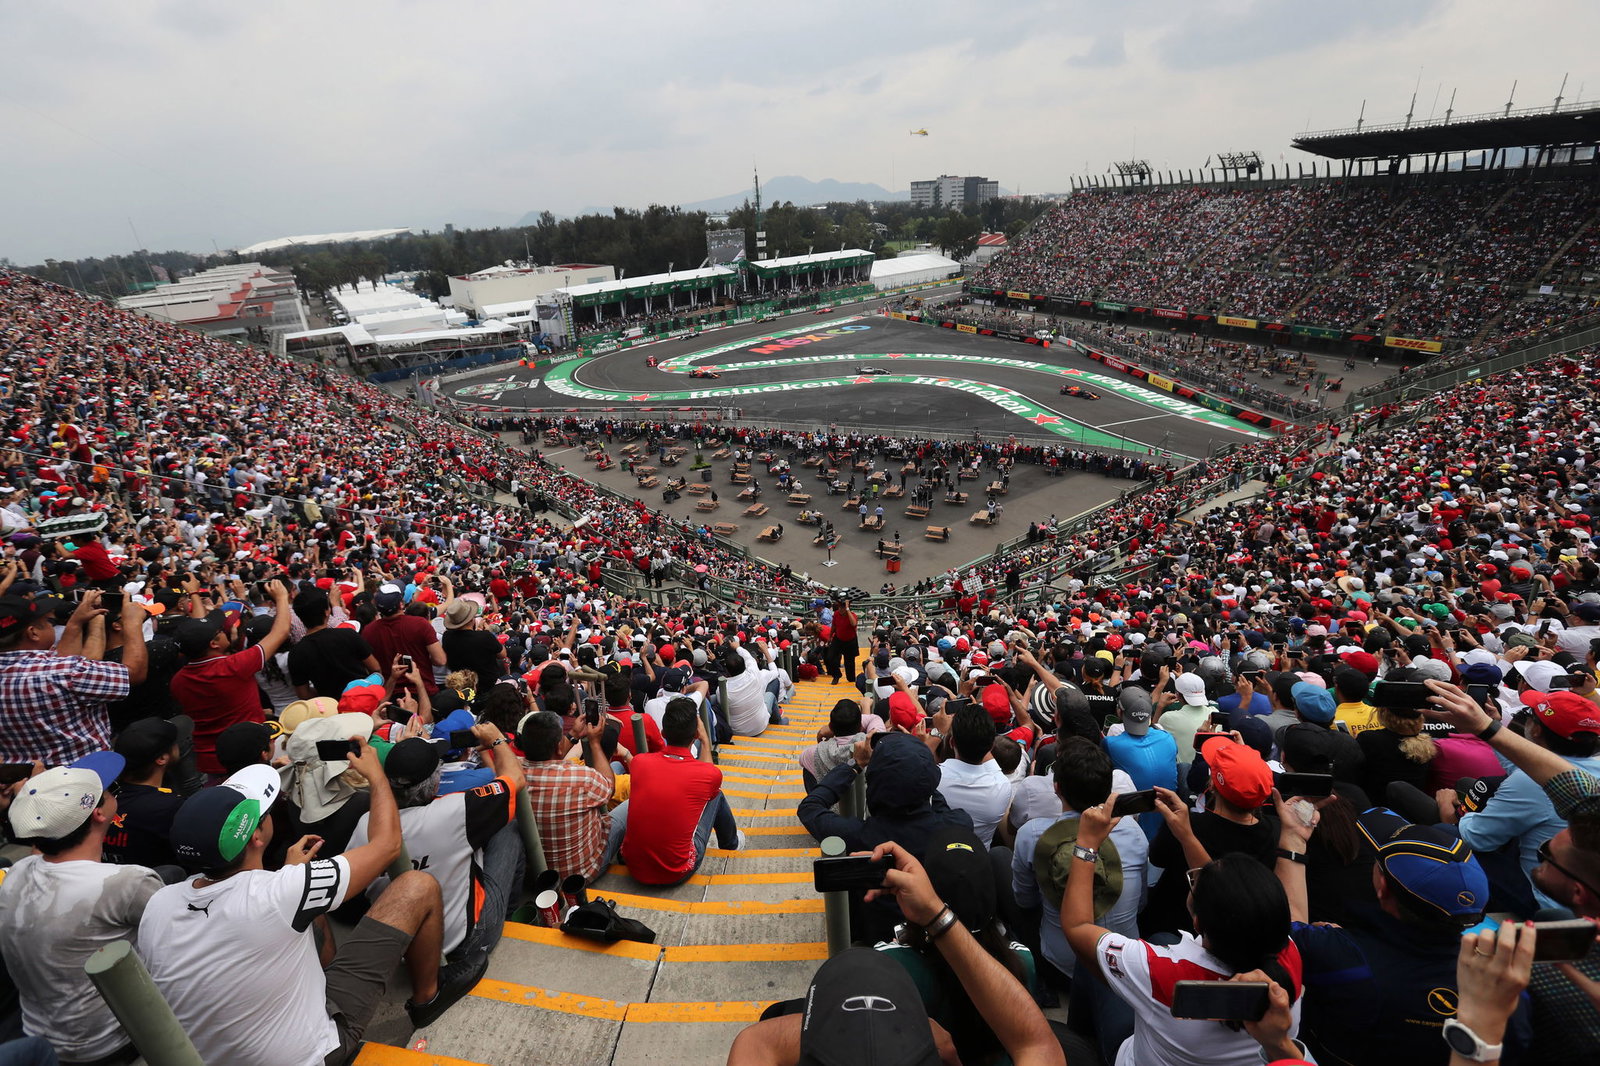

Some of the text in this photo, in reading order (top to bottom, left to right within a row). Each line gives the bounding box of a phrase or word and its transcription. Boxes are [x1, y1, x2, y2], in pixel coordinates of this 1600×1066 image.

[1165, 310, 1183, 318] Emirates
[1394, 338, 1426, 349] DHL
[727, 353, 856, 368] Heineken
[916, 353, 1047, 369] Heineken
[688, 379, 842, 400] Heineken
[911, 376, 1033, 414] Heineken
[1087, 374, 1214, 415] Heineken
[1422, 722, 1456, 731] TRONA
[263, 783, 275, 798] 11
[233, 813, 249, 839] JALISCO
[103, 831, 129, 848] ull
